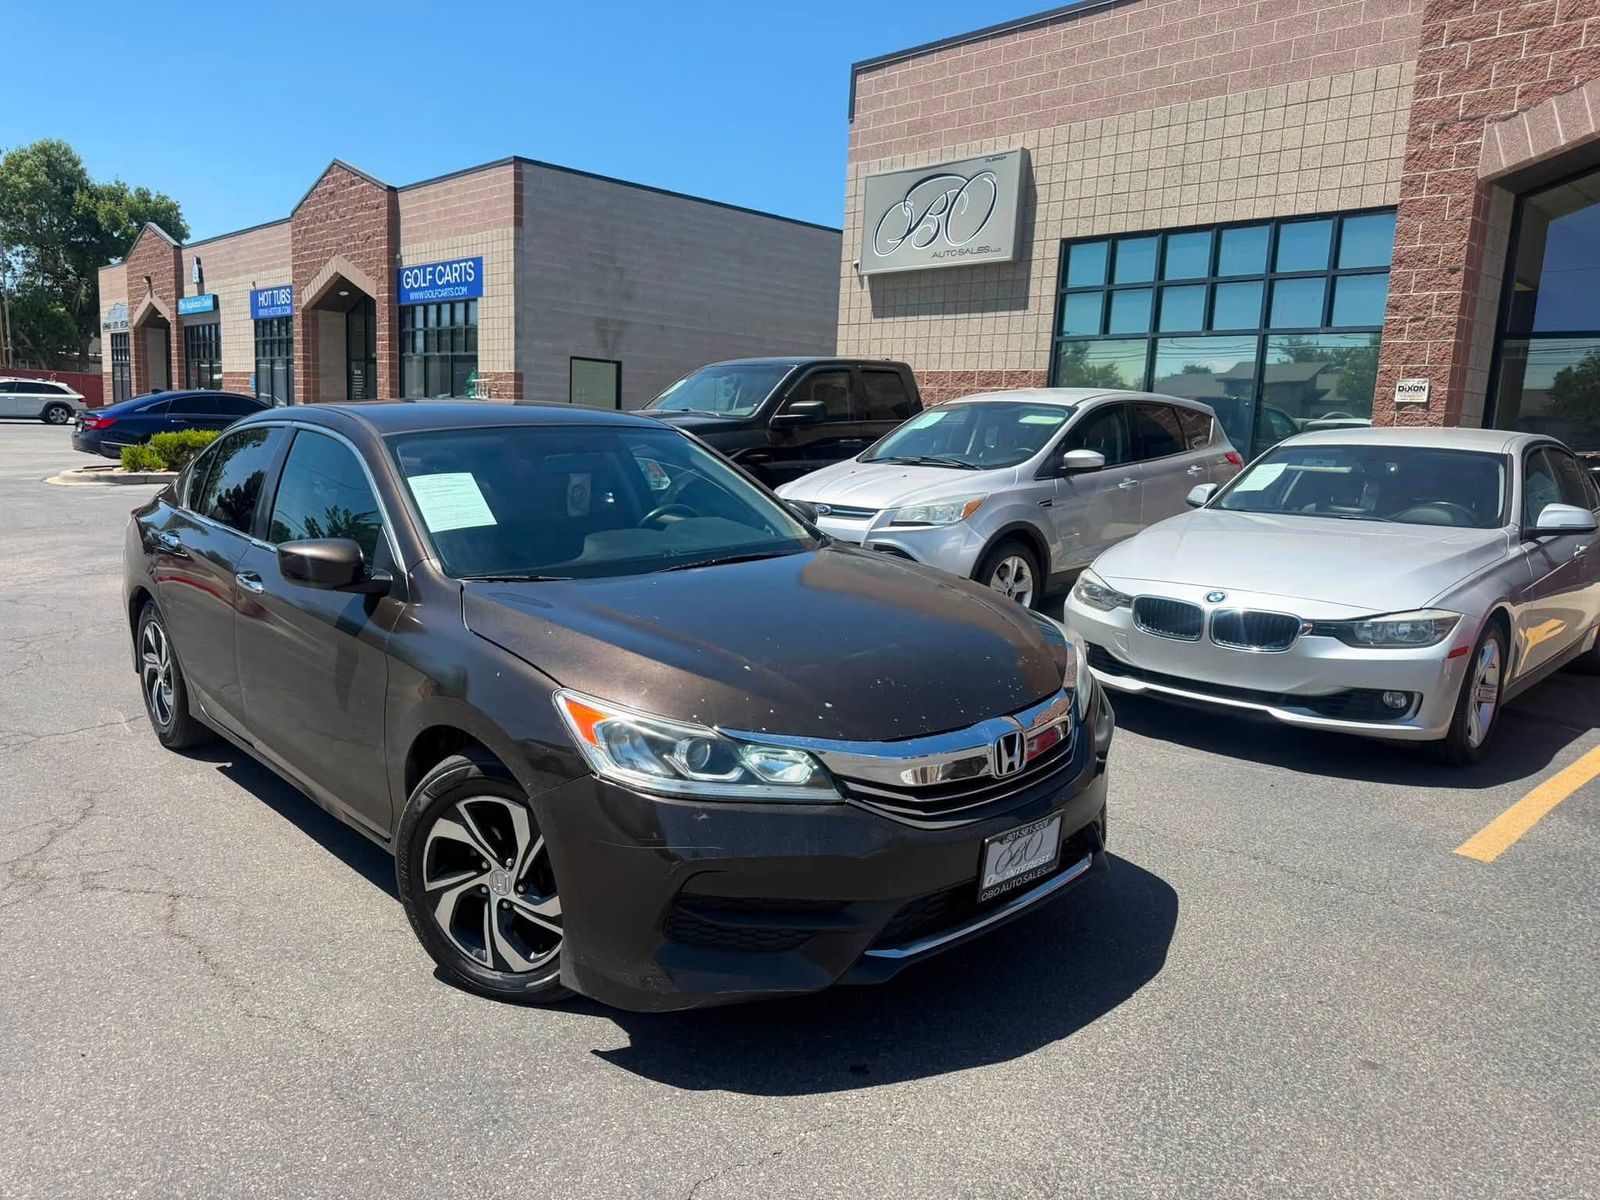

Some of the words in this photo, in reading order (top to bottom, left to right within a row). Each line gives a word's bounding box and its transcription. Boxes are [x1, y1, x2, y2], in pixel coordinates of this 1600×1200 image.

[931, 248, 957, 259] AUTO
[957, 245, 990, 256] SALES
[402, 267, 434, 290] GOLF
[435, 260, 475, 286] CARTS
[258, 290, 273, 307] HOT
[272, 288, 291, 305] TUBS
[409, 286, 468, 301] WWW.GOLFCARTS.COM
[981, 887, 1000, 901] OBO
[1000, 877, 1023, 894] AUTO
